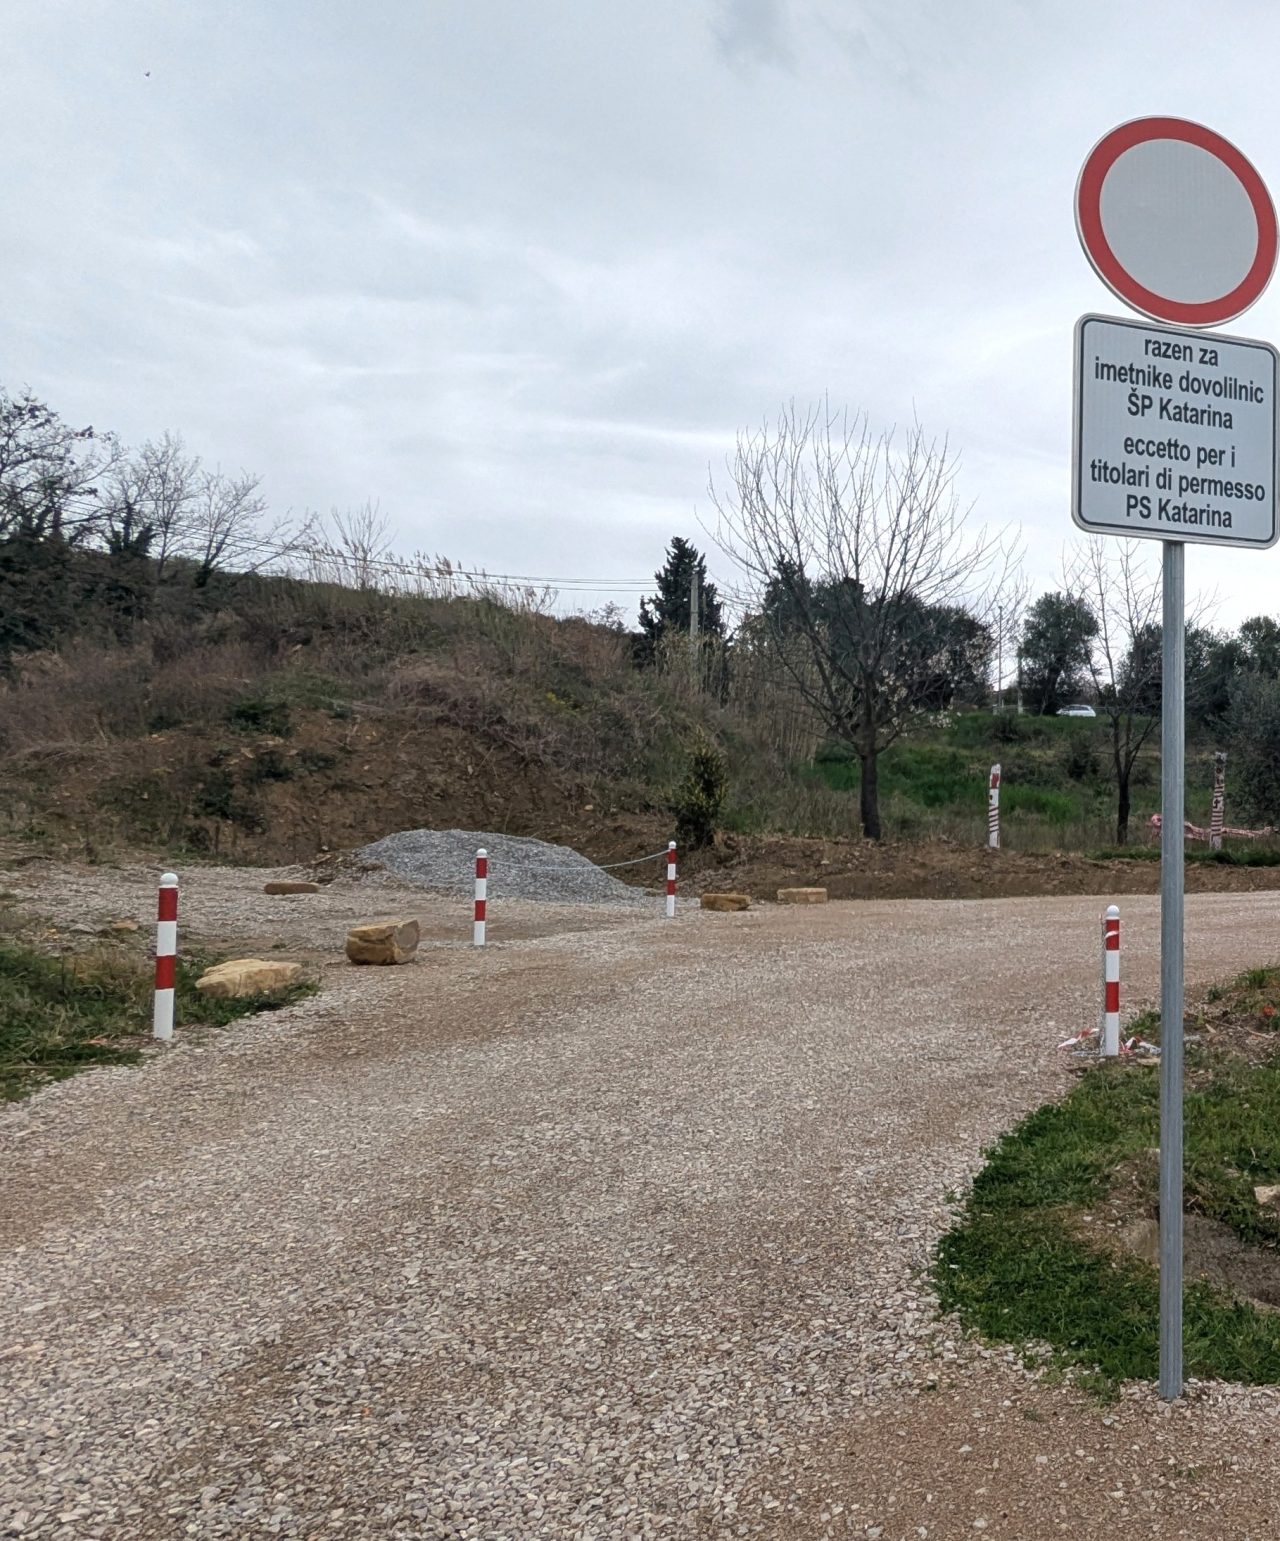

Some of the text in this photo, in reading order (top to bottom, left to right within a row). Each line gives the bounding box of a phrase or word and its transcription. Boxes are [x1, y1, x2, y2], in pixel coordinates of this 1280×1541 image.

[1144, 338, 1219, 367] razen za
[1095, 355, 1264, 404] imetnike dovolilnic
[1127, 386, 1233, 430] ŠP Katarina
[1123, 436, 1236, 469] eccetto per i
[1090, 458, 1266, 502] titolari di permesso
[1126, 493, 1233, 529] PS Katarina
